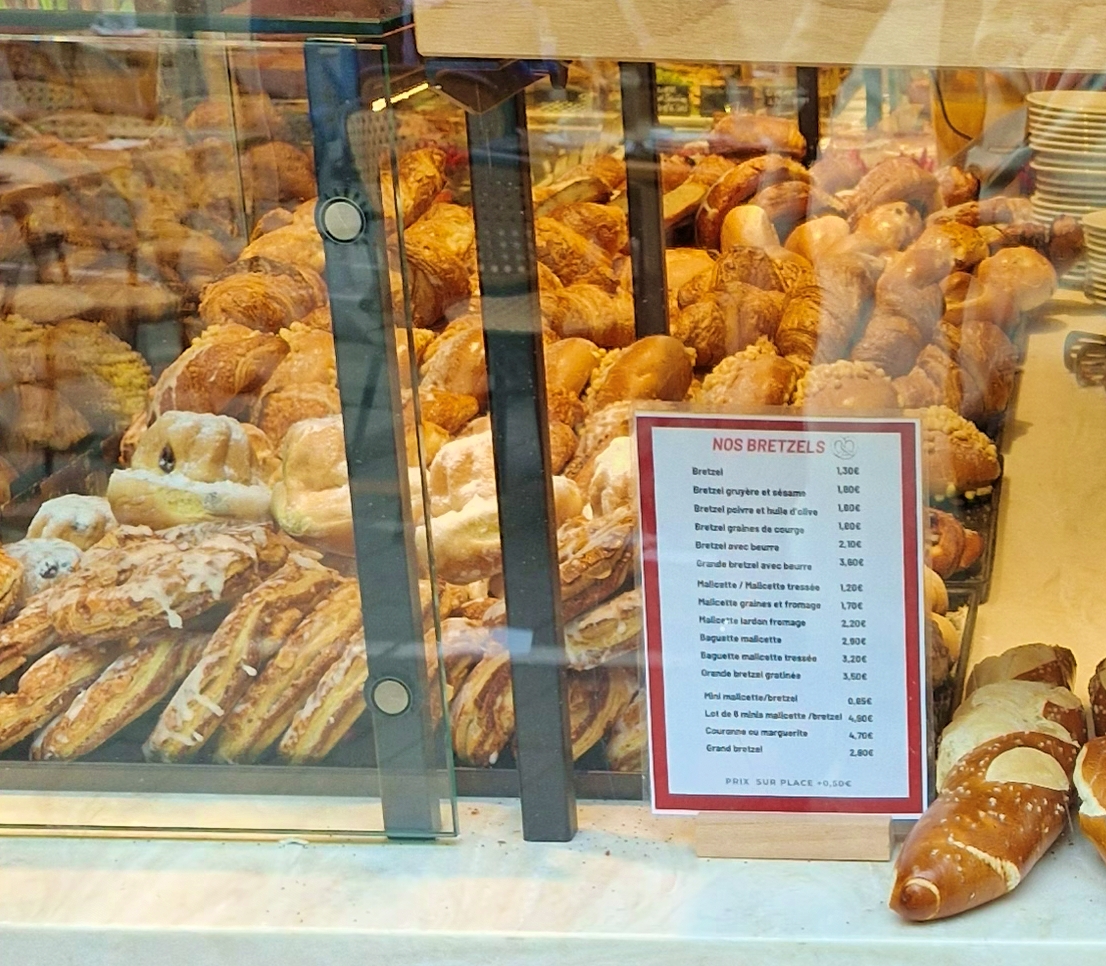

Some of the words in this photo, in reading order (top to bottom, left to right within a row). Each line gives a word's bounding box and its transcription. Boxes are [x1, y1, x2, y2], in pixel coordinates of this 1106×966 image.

[712, 438, 743, 452] NOS
[747, 439, 825, 454] BRETZELS
[692, 467, 723, 476] Bretzel
[836, 467, 860, 476] 1,30€
[693, 486, 724, 495] Bretzel
[726, 487, 759, 497] gruyère
[762, 488, 770, 496] et
[773, 488, 806, 497] sésame
[694, 505, 725, 514] Bretzel
[726, 506, 754, 515] poivre
[767, 506, 788, 515] huile
[790, 508, 818, 516] d'olive
[695, 523, 726, 532] Bretzel
[728, 524, 759, 534] graines
[762, 525, 772, 533] de
[774, 527, 804, 535] courge
[695, 541, 727, 550] Bretzel
[750, 543, 779, 551] beurre
[839, 540, 861, 549] 2,10€
[696, 560, 726, 569] Grande
[728, 560, 759, 569] bretzel
[783, 562, 812, 571] beurre
[697, 580, 737, 589] Malicette
[745, 581, 785, 590] Malicette
[787, 582, 820, 592] tressée
[840, 584, 863, 593] 1,20€
[698, 598, 738, 607] Malicette
[740, 599, 772, 609] graines
[774, 600, 783, 608] et
[785, 600, 821, 610] fromage
[841, 602, 863, 610] 1,70€
[740, 617, 768, 626] lardon
[770, 618, 806, 628] fromage
[841, 620, 866, 628] 2,20€
[700, 634, 739, 643] Baguette
[741, 635, 782, 644] malicette
[701, 651, 740, 661] Baguette
[741, 652, 783, 662] malicette
[785, 654, 817, 663] tressée
[842, 655, 867, 663] 3,20€
[701, 669, 731, 678] Grande
[734, 670, 763, 679] bretzel
[704, 692, 721, 700] Mini
[705, 710, 720, 718] Lot
[721, 710, 732, 718] de
[741, 711, 763, 719] minis
[765, 711, 806, 720] malicette
[808, 712, 842, 721] /bretzel
[705, 727, 746, 736] Couronne
[748, 729, 759, 737] ou
[761, 729, 808, 739] marguerite
[849, 732, 873, 740] 4,70€
[706, 744, 731, 753] Grand
[733, 745, 763, 753] bretzel
[817, 780, 852, 788] +0,50€
